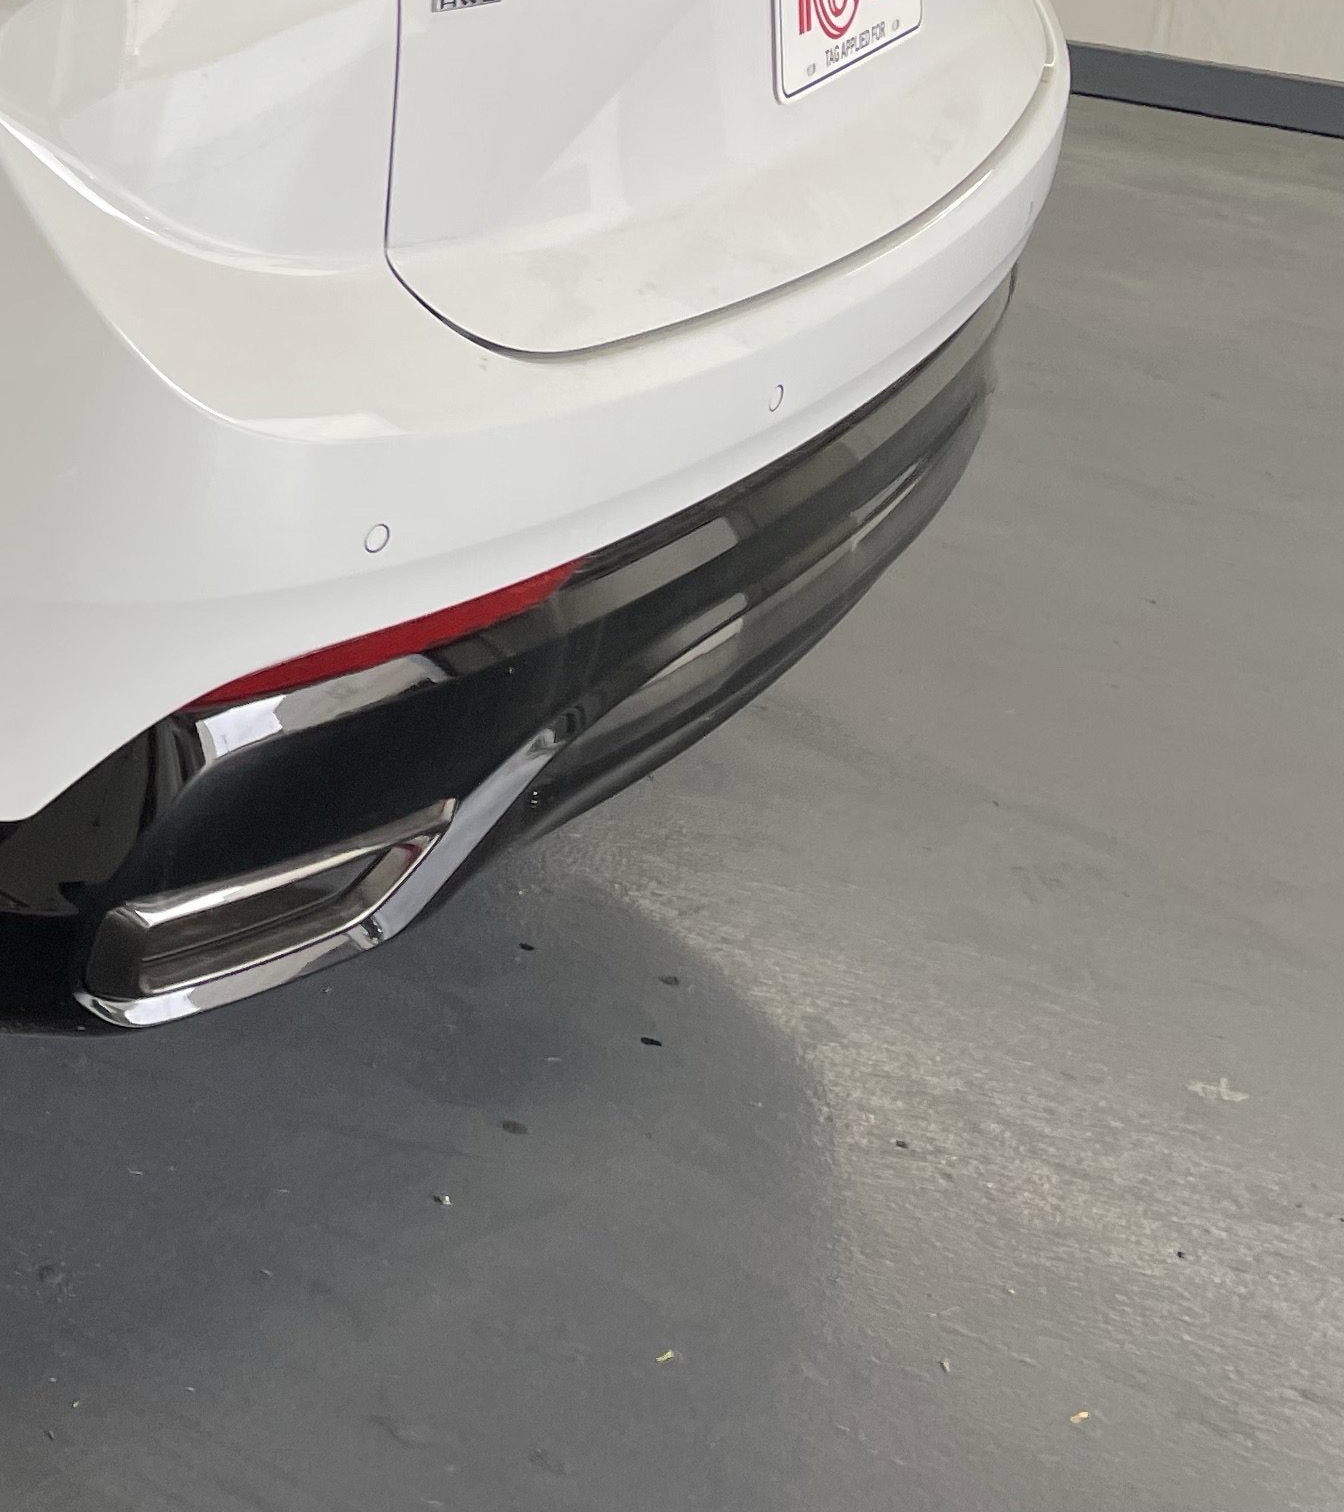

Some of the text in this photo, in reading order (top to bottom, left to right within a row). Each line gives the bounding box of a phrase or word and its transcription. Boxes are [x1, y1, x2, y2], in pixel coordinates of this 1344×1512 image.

[825, 20, 886, 67] TAG APPLIED FOR
